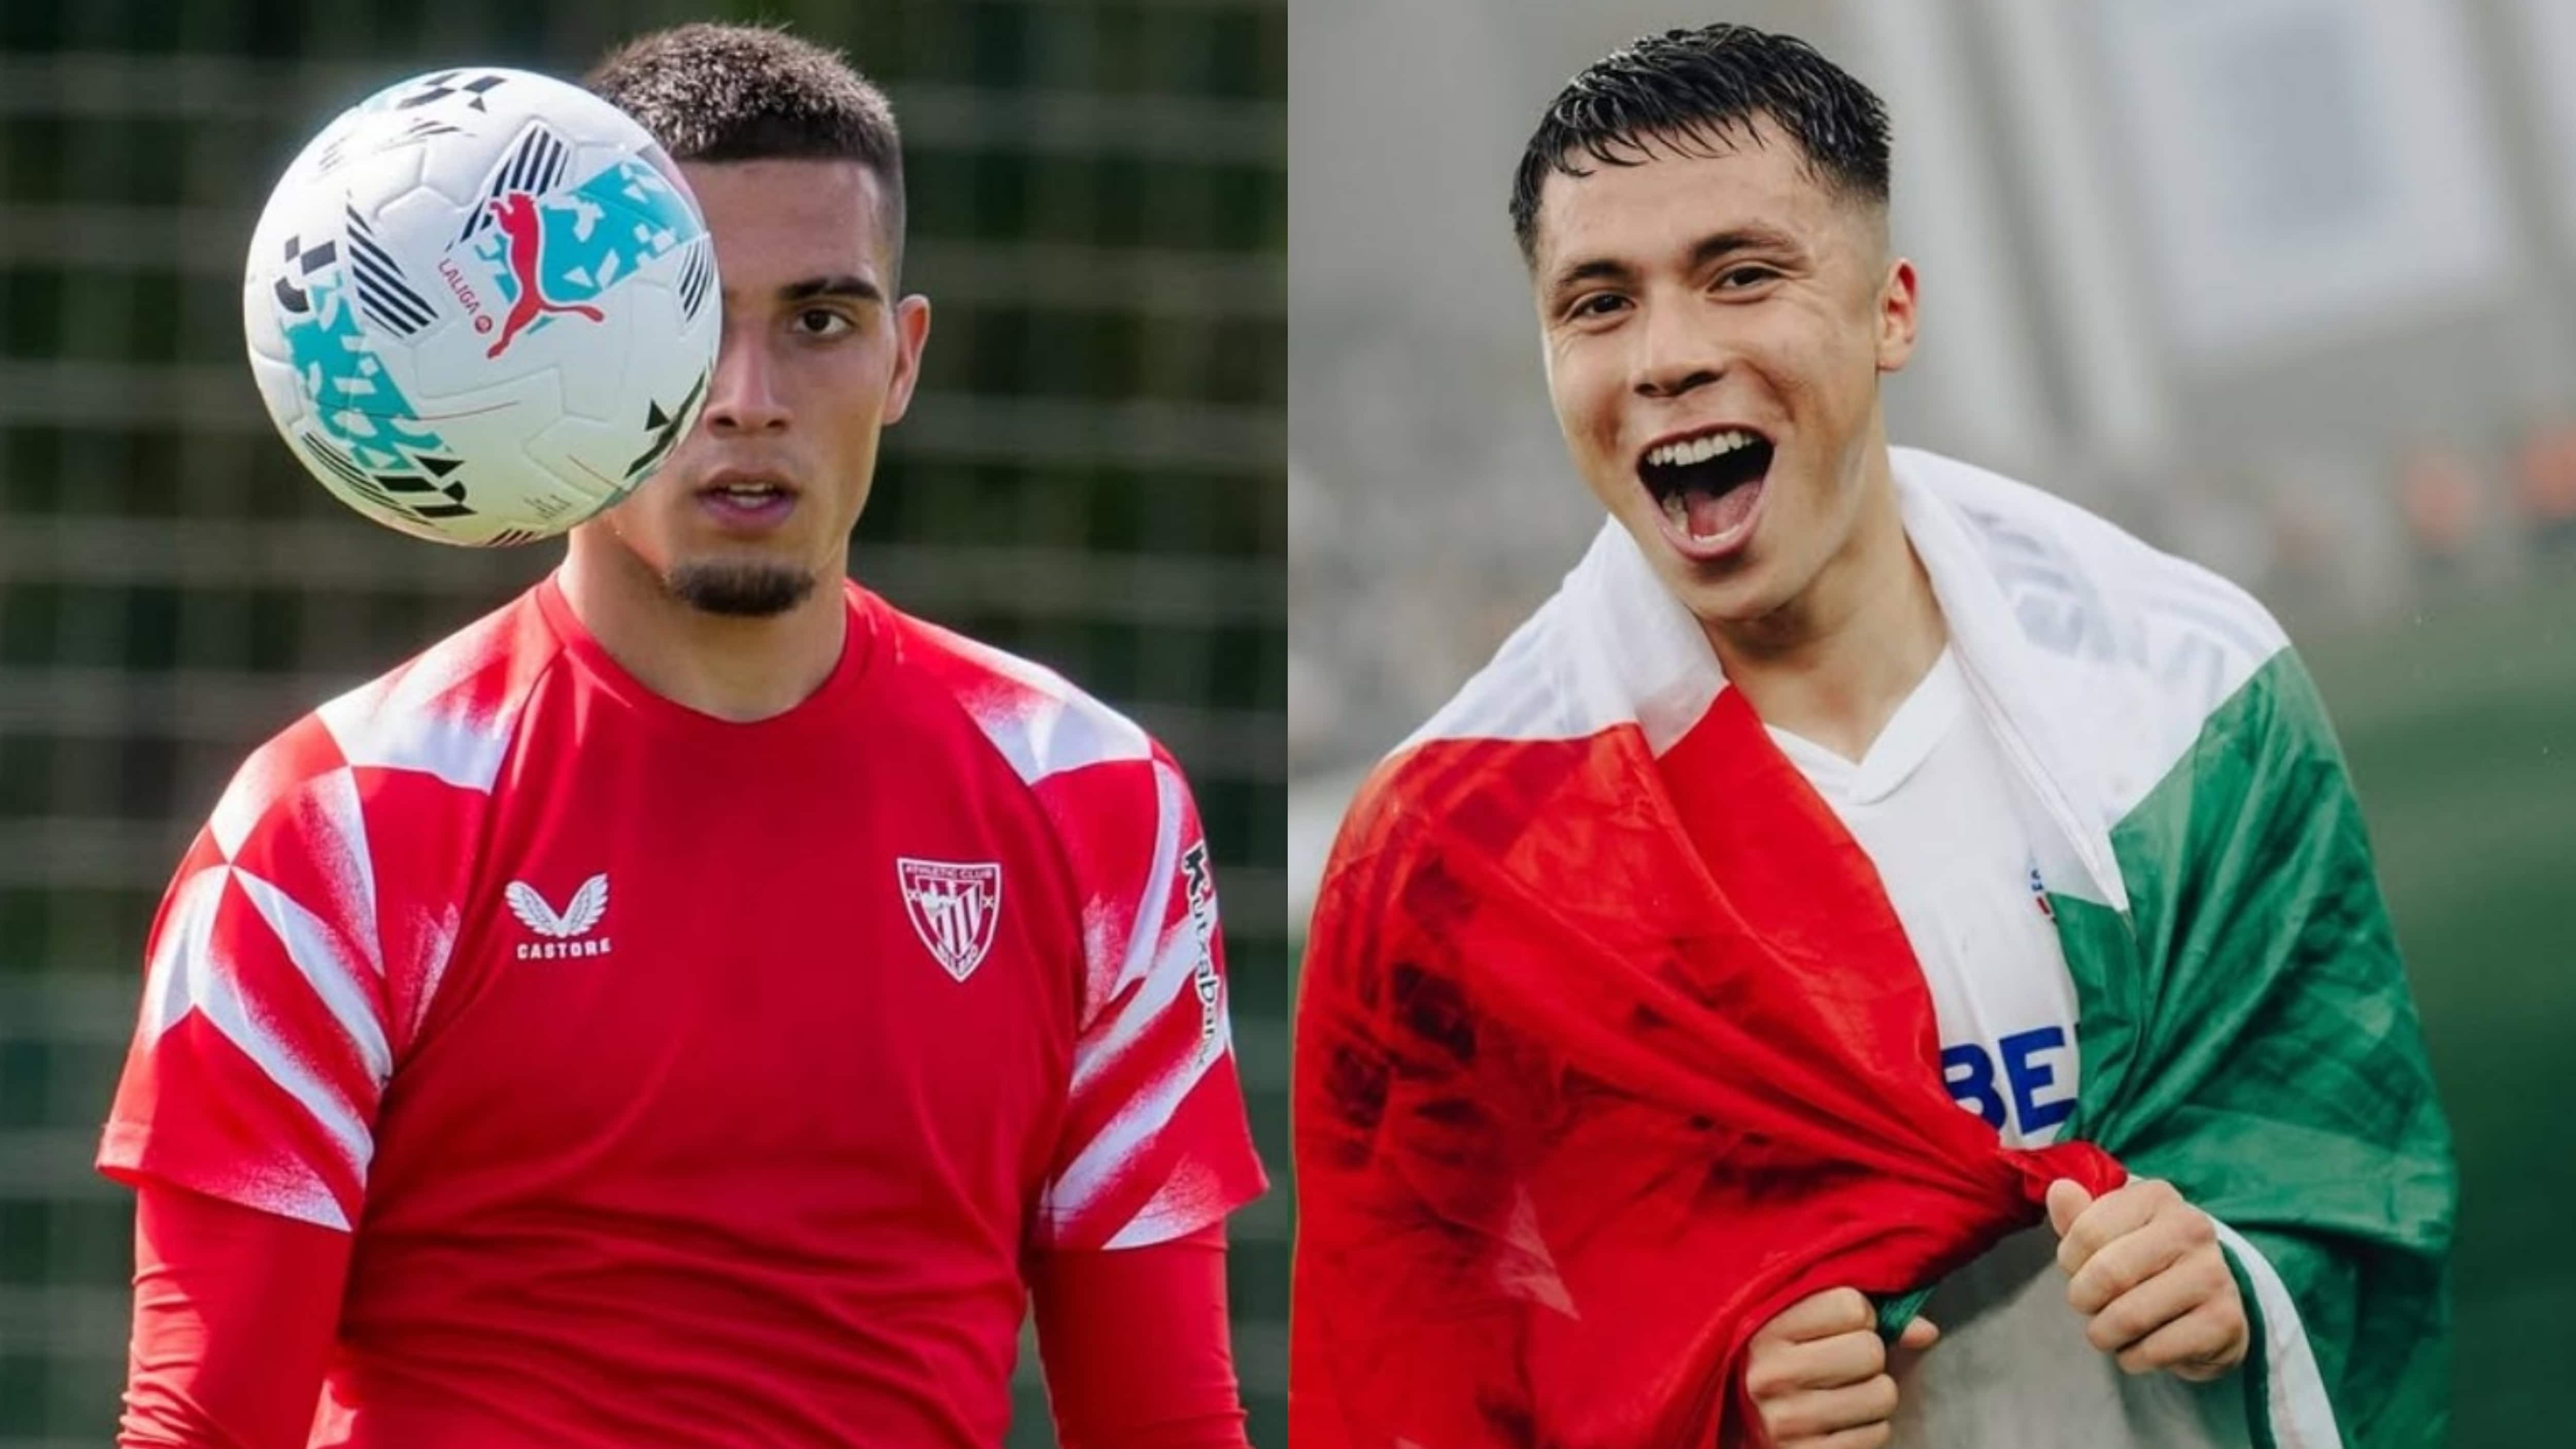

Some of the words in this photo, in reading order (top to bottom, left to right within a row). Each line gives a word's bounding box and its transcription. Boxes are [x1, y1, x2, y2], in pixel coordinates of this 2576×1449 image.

[439, 258, 480, 315] LALIGA
[959, 868, 993, 879] CLUB
[517, 937, 611, 960] CASTORE
[1941, 1026, 2078, 1135] BE
